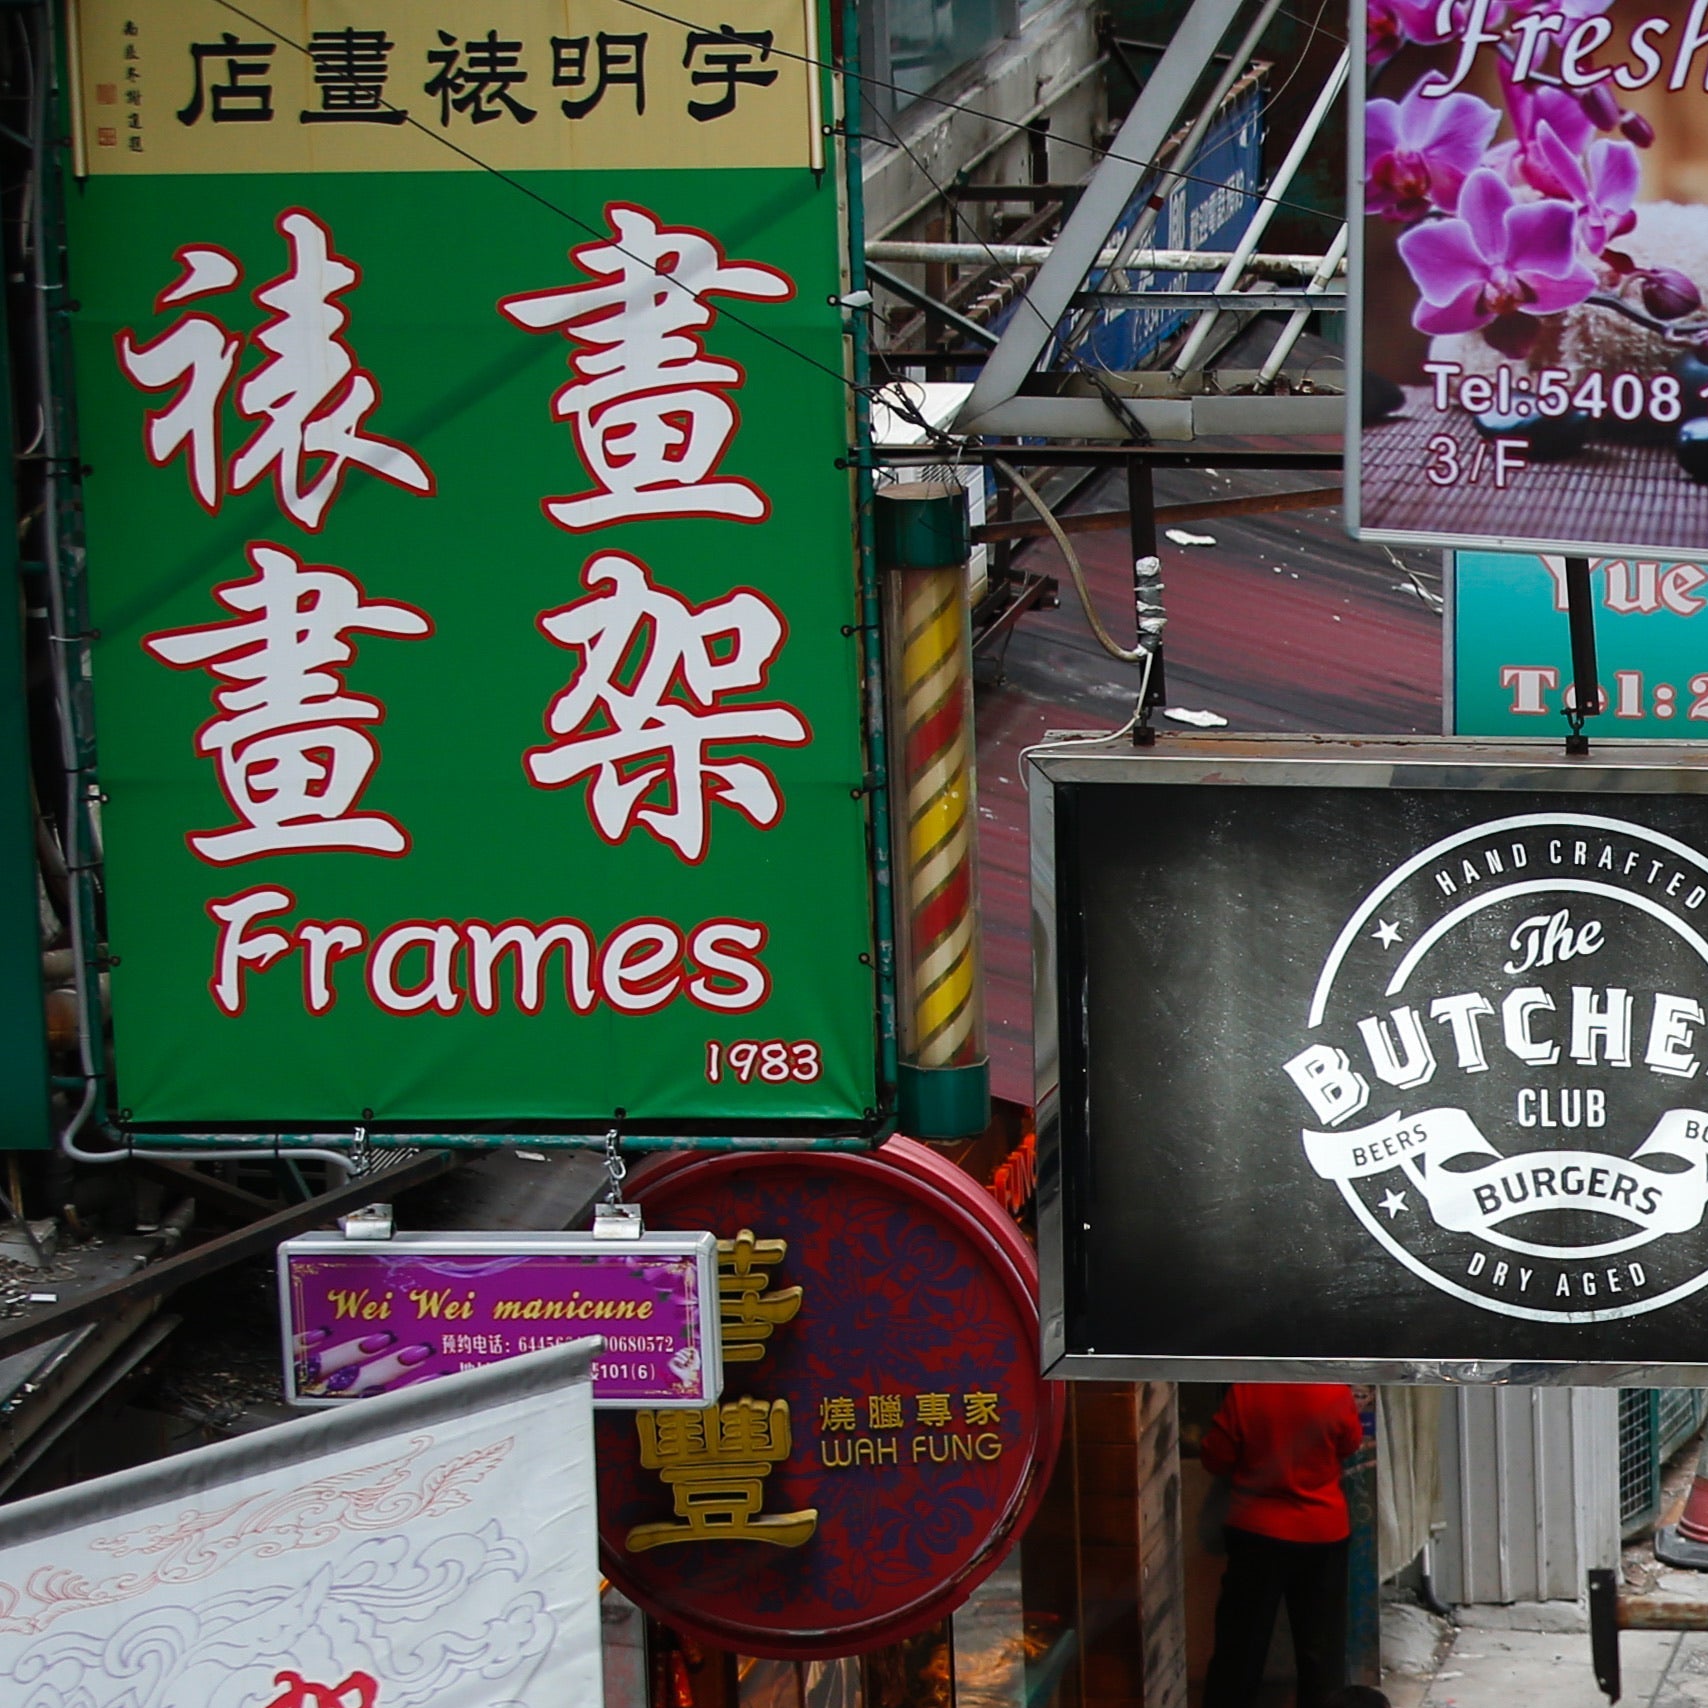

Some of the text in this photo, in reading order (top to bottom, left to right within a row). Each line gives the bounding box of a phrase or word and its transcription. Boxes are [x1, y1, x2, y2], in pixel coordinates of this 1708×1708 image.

[1424, 437, 1530, 491] 3/F
[1434, 838, 1708, 911] HAND CRAFTED
[207, 885, 774, 1017] Frames
[1502, 907, 1606, 975] The
[705, 1039, 822, 1084] 1983
[1516, 1088, 1607, 1129] CLUB
[1351, 1122, 1429, 1168] BEERS
[1472, 1165, 1663, 1217] BURGERS
[1466, 1251, 1647, 1297] DRY AGED
[327, 1288, 394, 1323] Wei
[409, 1288, 477, 1323] Wei
[820, 1432, 1002, 1468] WAH FUNG
